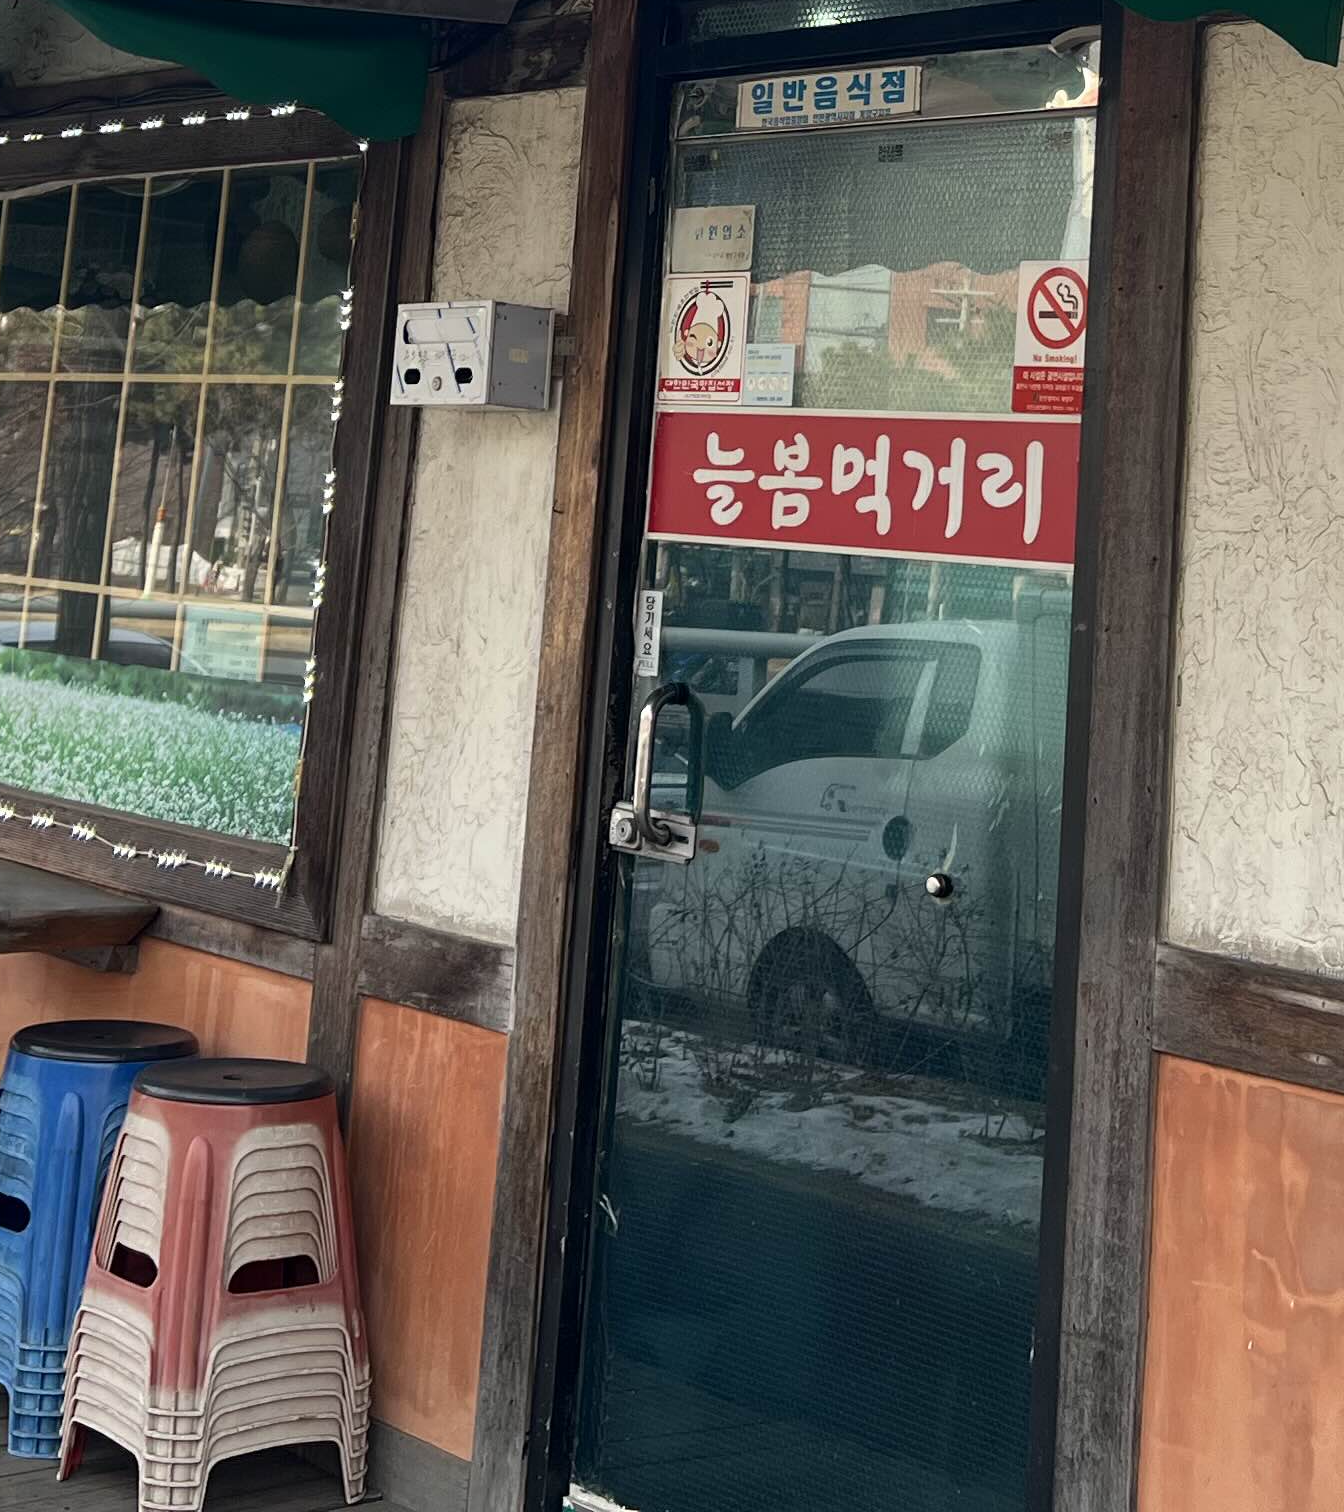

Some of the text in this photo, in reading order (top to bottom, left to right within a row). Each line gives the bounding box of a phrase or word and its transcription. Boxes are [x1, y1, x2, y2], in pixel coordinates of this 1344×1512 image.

[751, 70, 906, 115] 일반음식점
[664, 379, 734, 392] 대한민국맛집선정
[692, 431, 1045, 546] 늘봄먹거리
[641, 595, 656, 656] 당기세요
